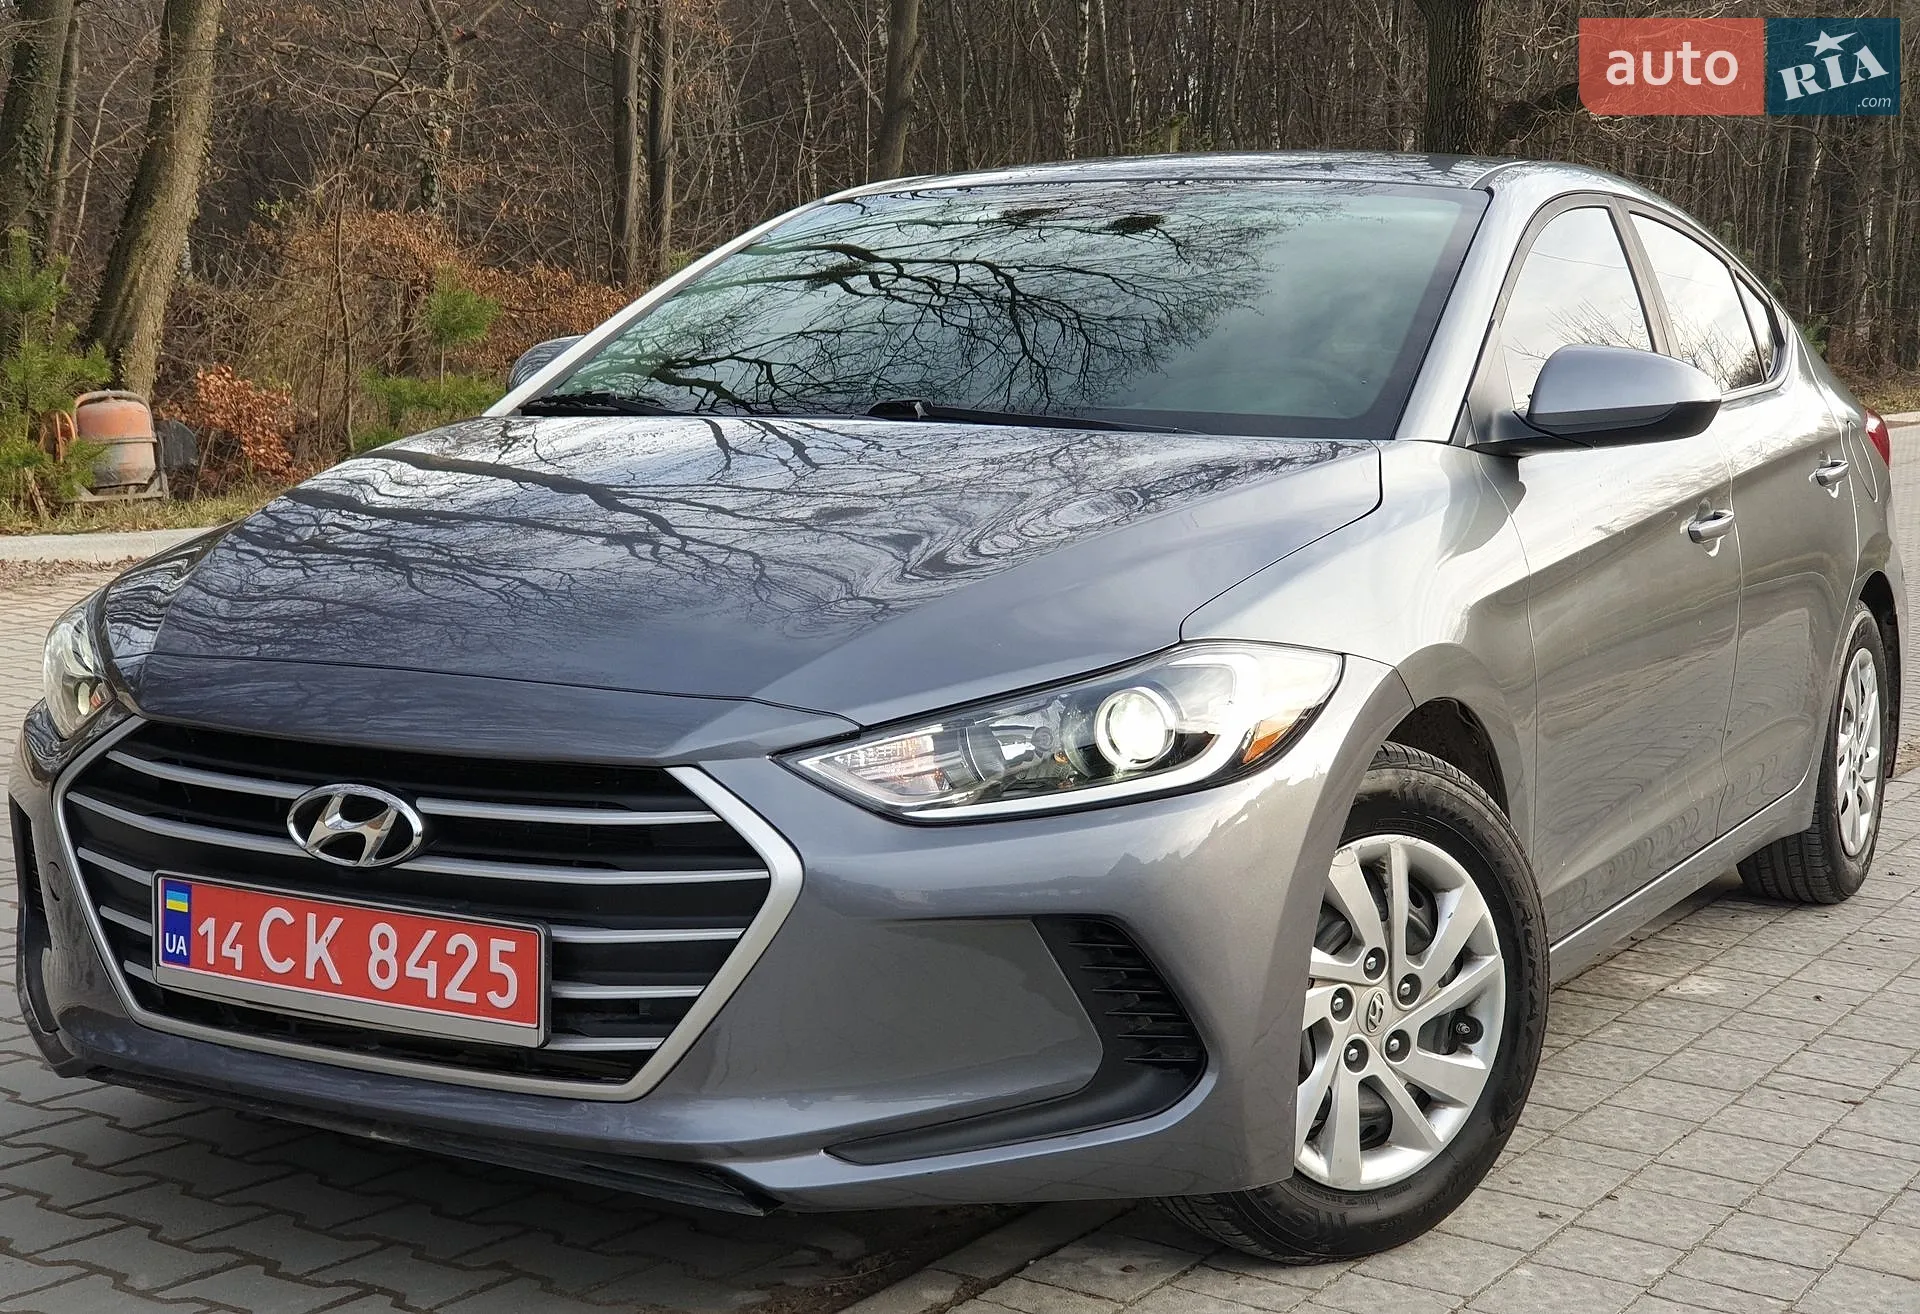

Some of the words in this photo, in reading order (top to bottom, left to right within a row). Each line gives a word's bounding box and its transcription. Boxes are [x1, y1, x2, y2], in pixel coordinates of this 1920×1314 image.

[165, 932, 188, 957] UA
[197, 916, 244, 971] 14
[257, 906, 344, 986] CK
[367, 922, 519, 1009] 8425
